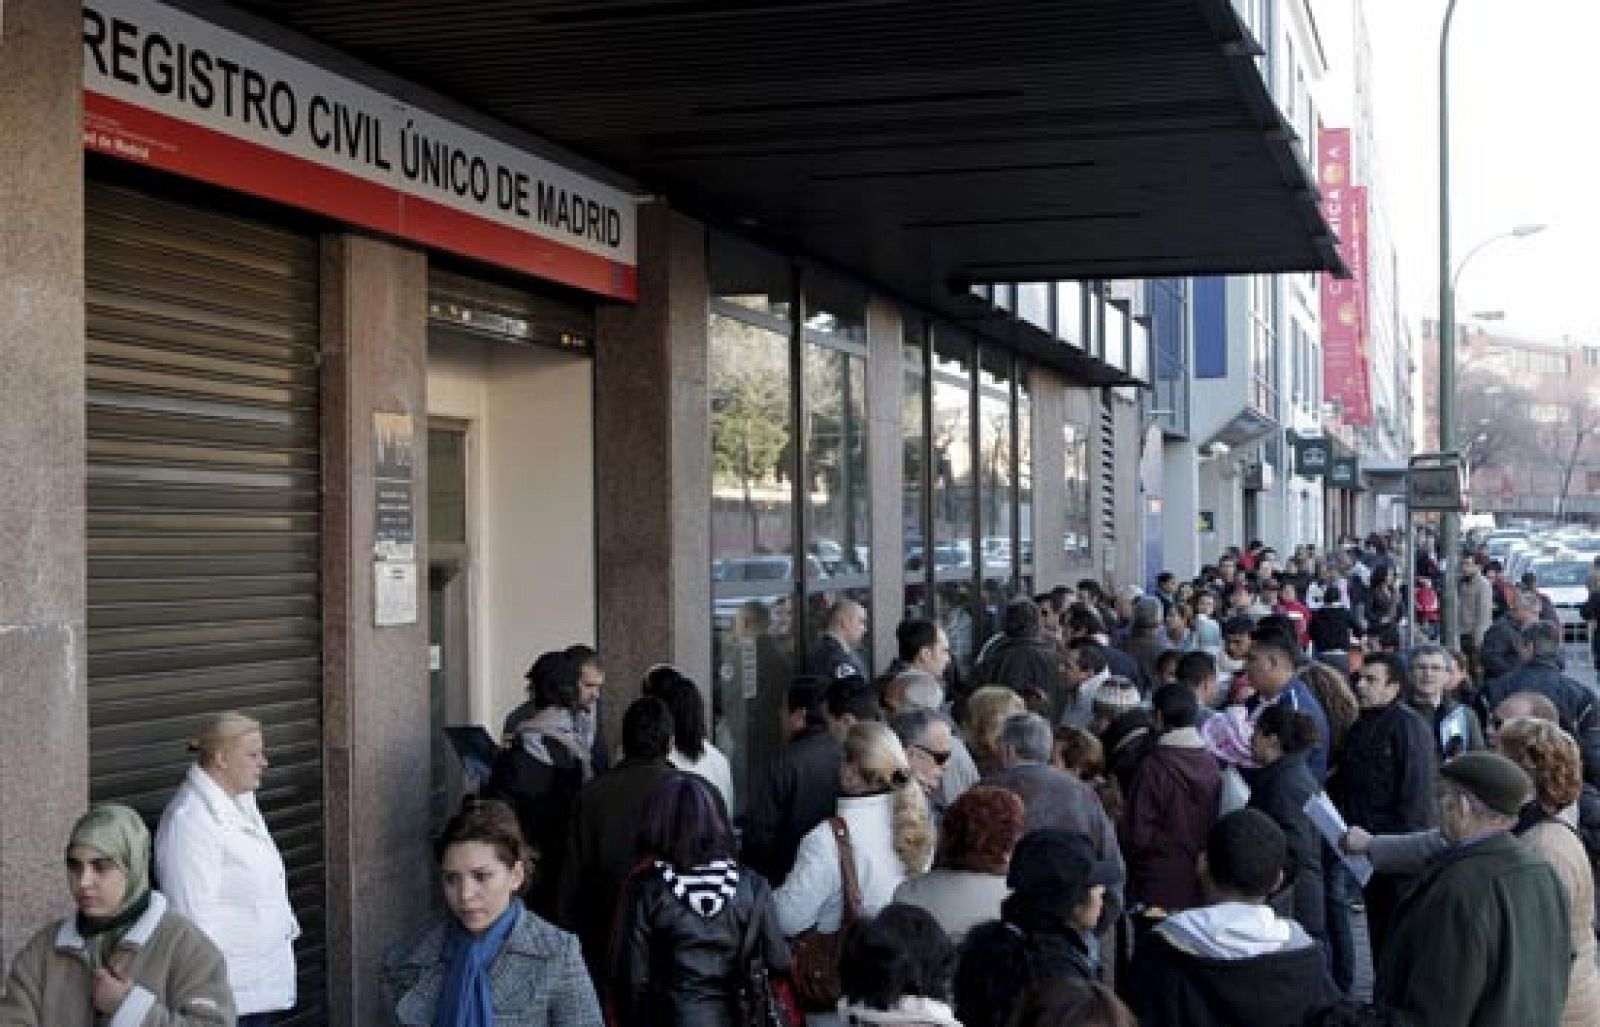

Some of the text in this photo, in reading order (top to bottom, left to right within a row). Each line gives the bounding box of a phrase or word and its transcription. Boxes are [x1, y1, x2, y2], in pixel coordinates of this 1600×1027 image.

[82, 6, 621, 249] REGISTRO CIVIL ÚNICO DE MADRID
